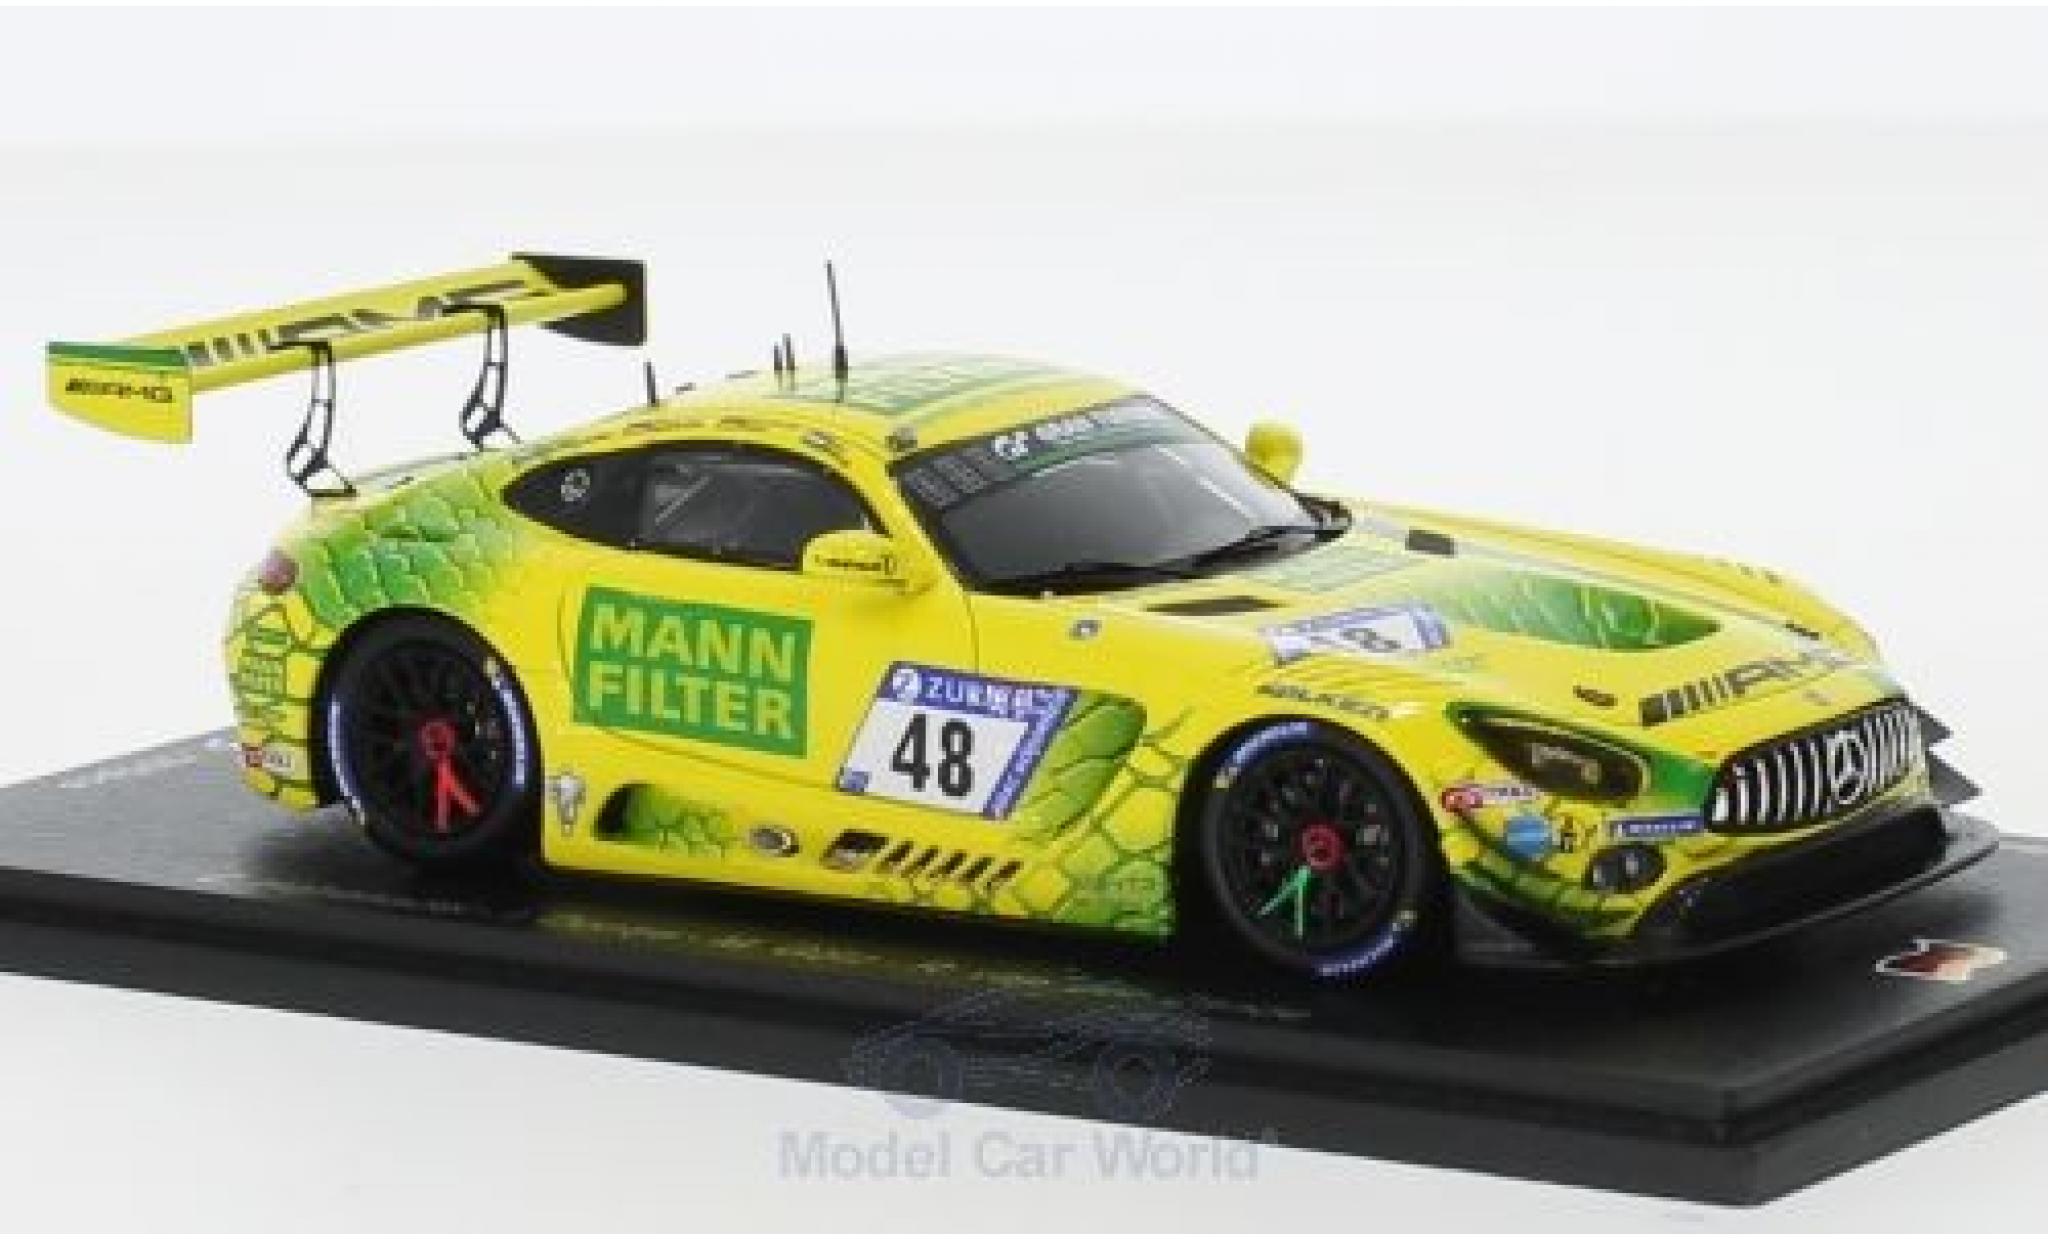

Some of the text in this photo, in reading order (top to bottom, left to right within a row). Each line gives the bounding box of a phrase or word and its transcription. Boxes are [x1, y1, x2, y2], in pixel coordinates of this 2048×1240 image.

[589, 603, 796, 684] MANN
[587, 660, 793, 741] FILTER
[892, 713, 974, 797] 48
